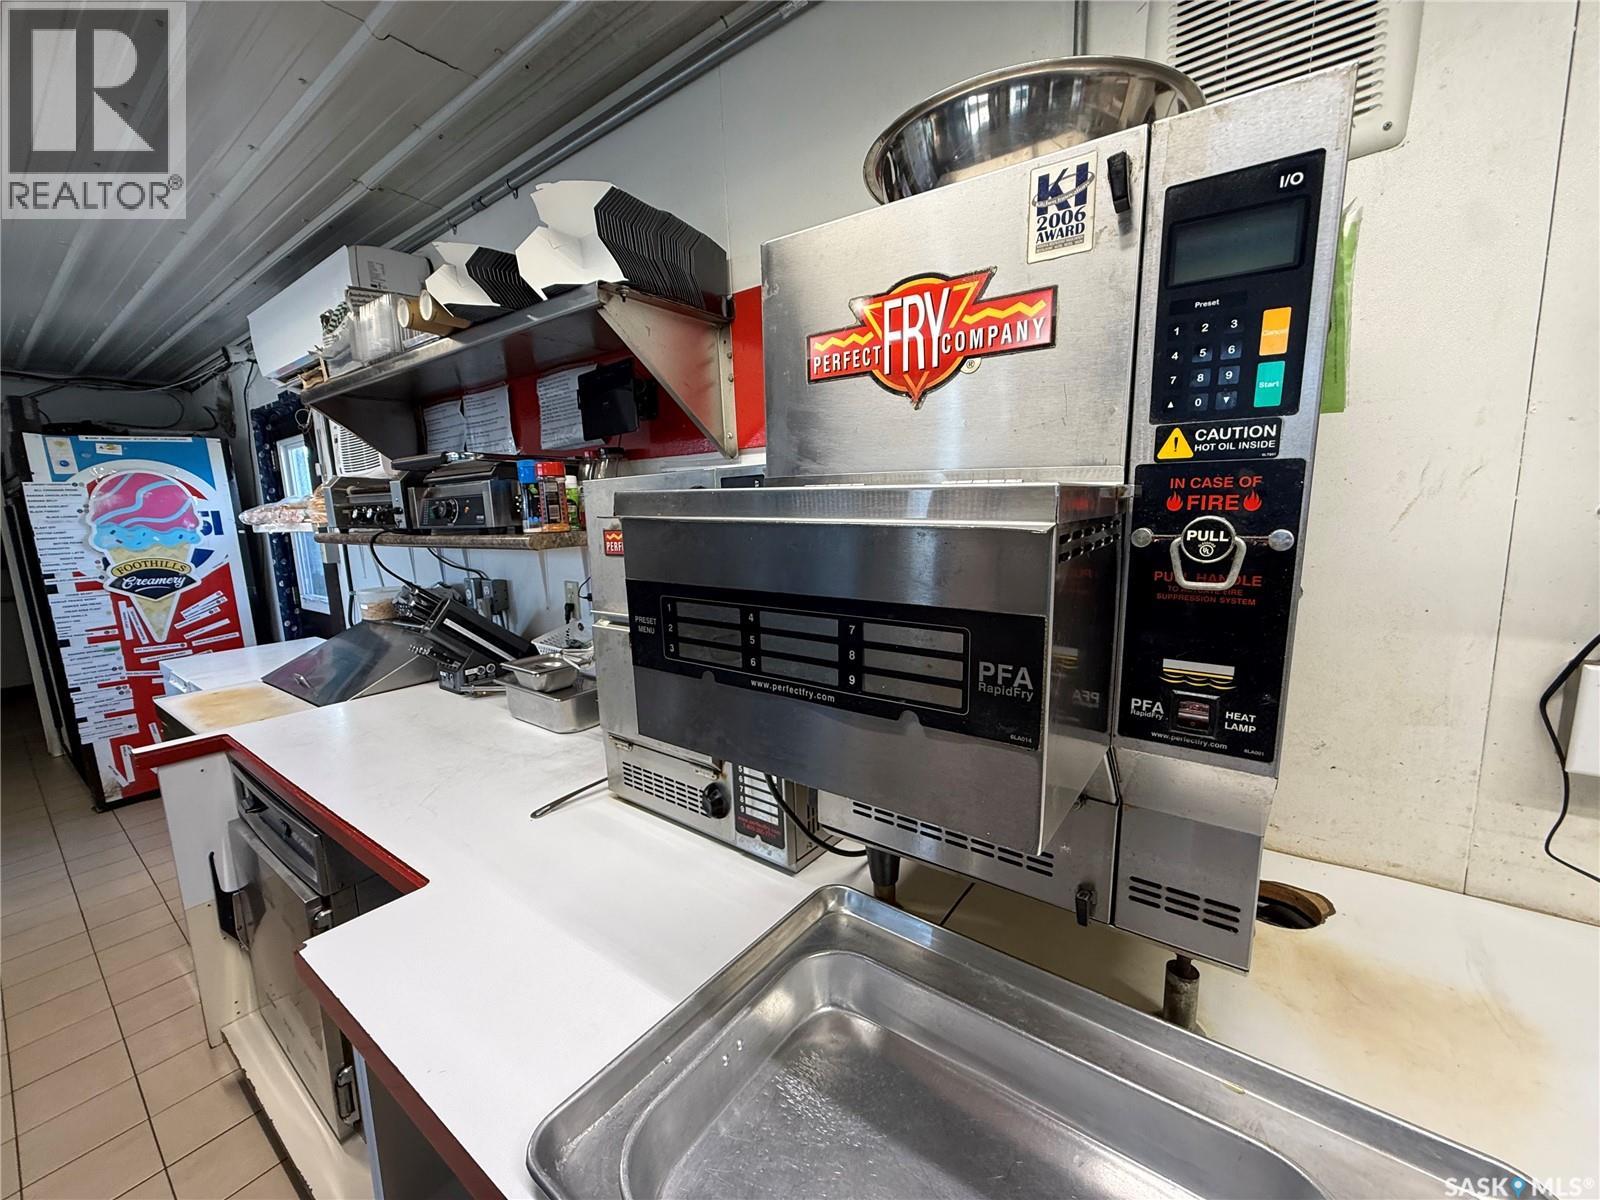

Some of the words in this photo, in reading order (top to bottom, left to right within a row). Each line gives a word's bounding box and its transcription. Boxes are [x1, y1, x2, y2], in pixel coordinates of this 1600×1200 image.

[1280, 172, 1304, 188] I/O
[1037, 205, 1086, 232] 2006
[1036, 222, 1085, 244] AWARD
[1194, 299, 1220, 308] Preset
[813, 345, 881, 375] PERFECT
[882, 287, 950, 376] FRY
[940, 317, 1045, 354] COMPANY
[1174, 327, 1180, 336] 1
[1201, 323, 1209, 332] 2
[1230, 319, 1238, 328] 3
[1171, 352, 1179, 360] 4
[1199, 348, 1207, 357] 5
[1228, 345, 1236, 354] 6
[1170, 376, 1177, 385] 7
[1196, 373, 1204, 382] 8
[1225, 370, 1233, 379] 9
[1195, 424, 1277, 441] CAUTION
[1194, 443, 1216, 452] HOT
[1218, 442, 1236, 450] OIL
[1238, 440, 1276, 449] INSIDE
[1170, 478, 1185, 489] IN
[1190, 476, 1234, 488] CASE
[1239, 476, 1263, 488] OF
[1187, 494, 1240, 510] FIRE
[1186, 530, 1229, 542] PULL
[116, 559, 188, 576] FOOTHILLS
[121, 576, 186, 589] Creamery
[1156, 593, 1217, 604] SUPPRESSION
[1219, 597, 1256, 606] SYSTEM
[667, 603, 671, 612] 1
[634, 615, 656, 625] PRESET
[748, 613, 754, 622] 4
[638, 625, 655, 634] MENU
[668, 623, 673, 632] 2
[849, 625, 856, 635] 7
[750, 635, 755, 644] 5
[669, 643, 674, 652] 3
[750, 657, 756, 666] 6
[848, 650, 855, 660] 8
[848, 675, 855, 685] 9
[979, 661, 1033, 690] PFA
[751, 679, 835, 703] www.perfectfry.com
[978, 681, 1034, 702] RapidFry
[1131, 697, 1164, 714] PFA
[1131, 709, 1163, 720] RapidFry
[1225, 711, 1256, 723] HEAT
[1224, 721, 1256, 733] LAMP
[1151, 731, 1228, 749] www.perfectfry.com
